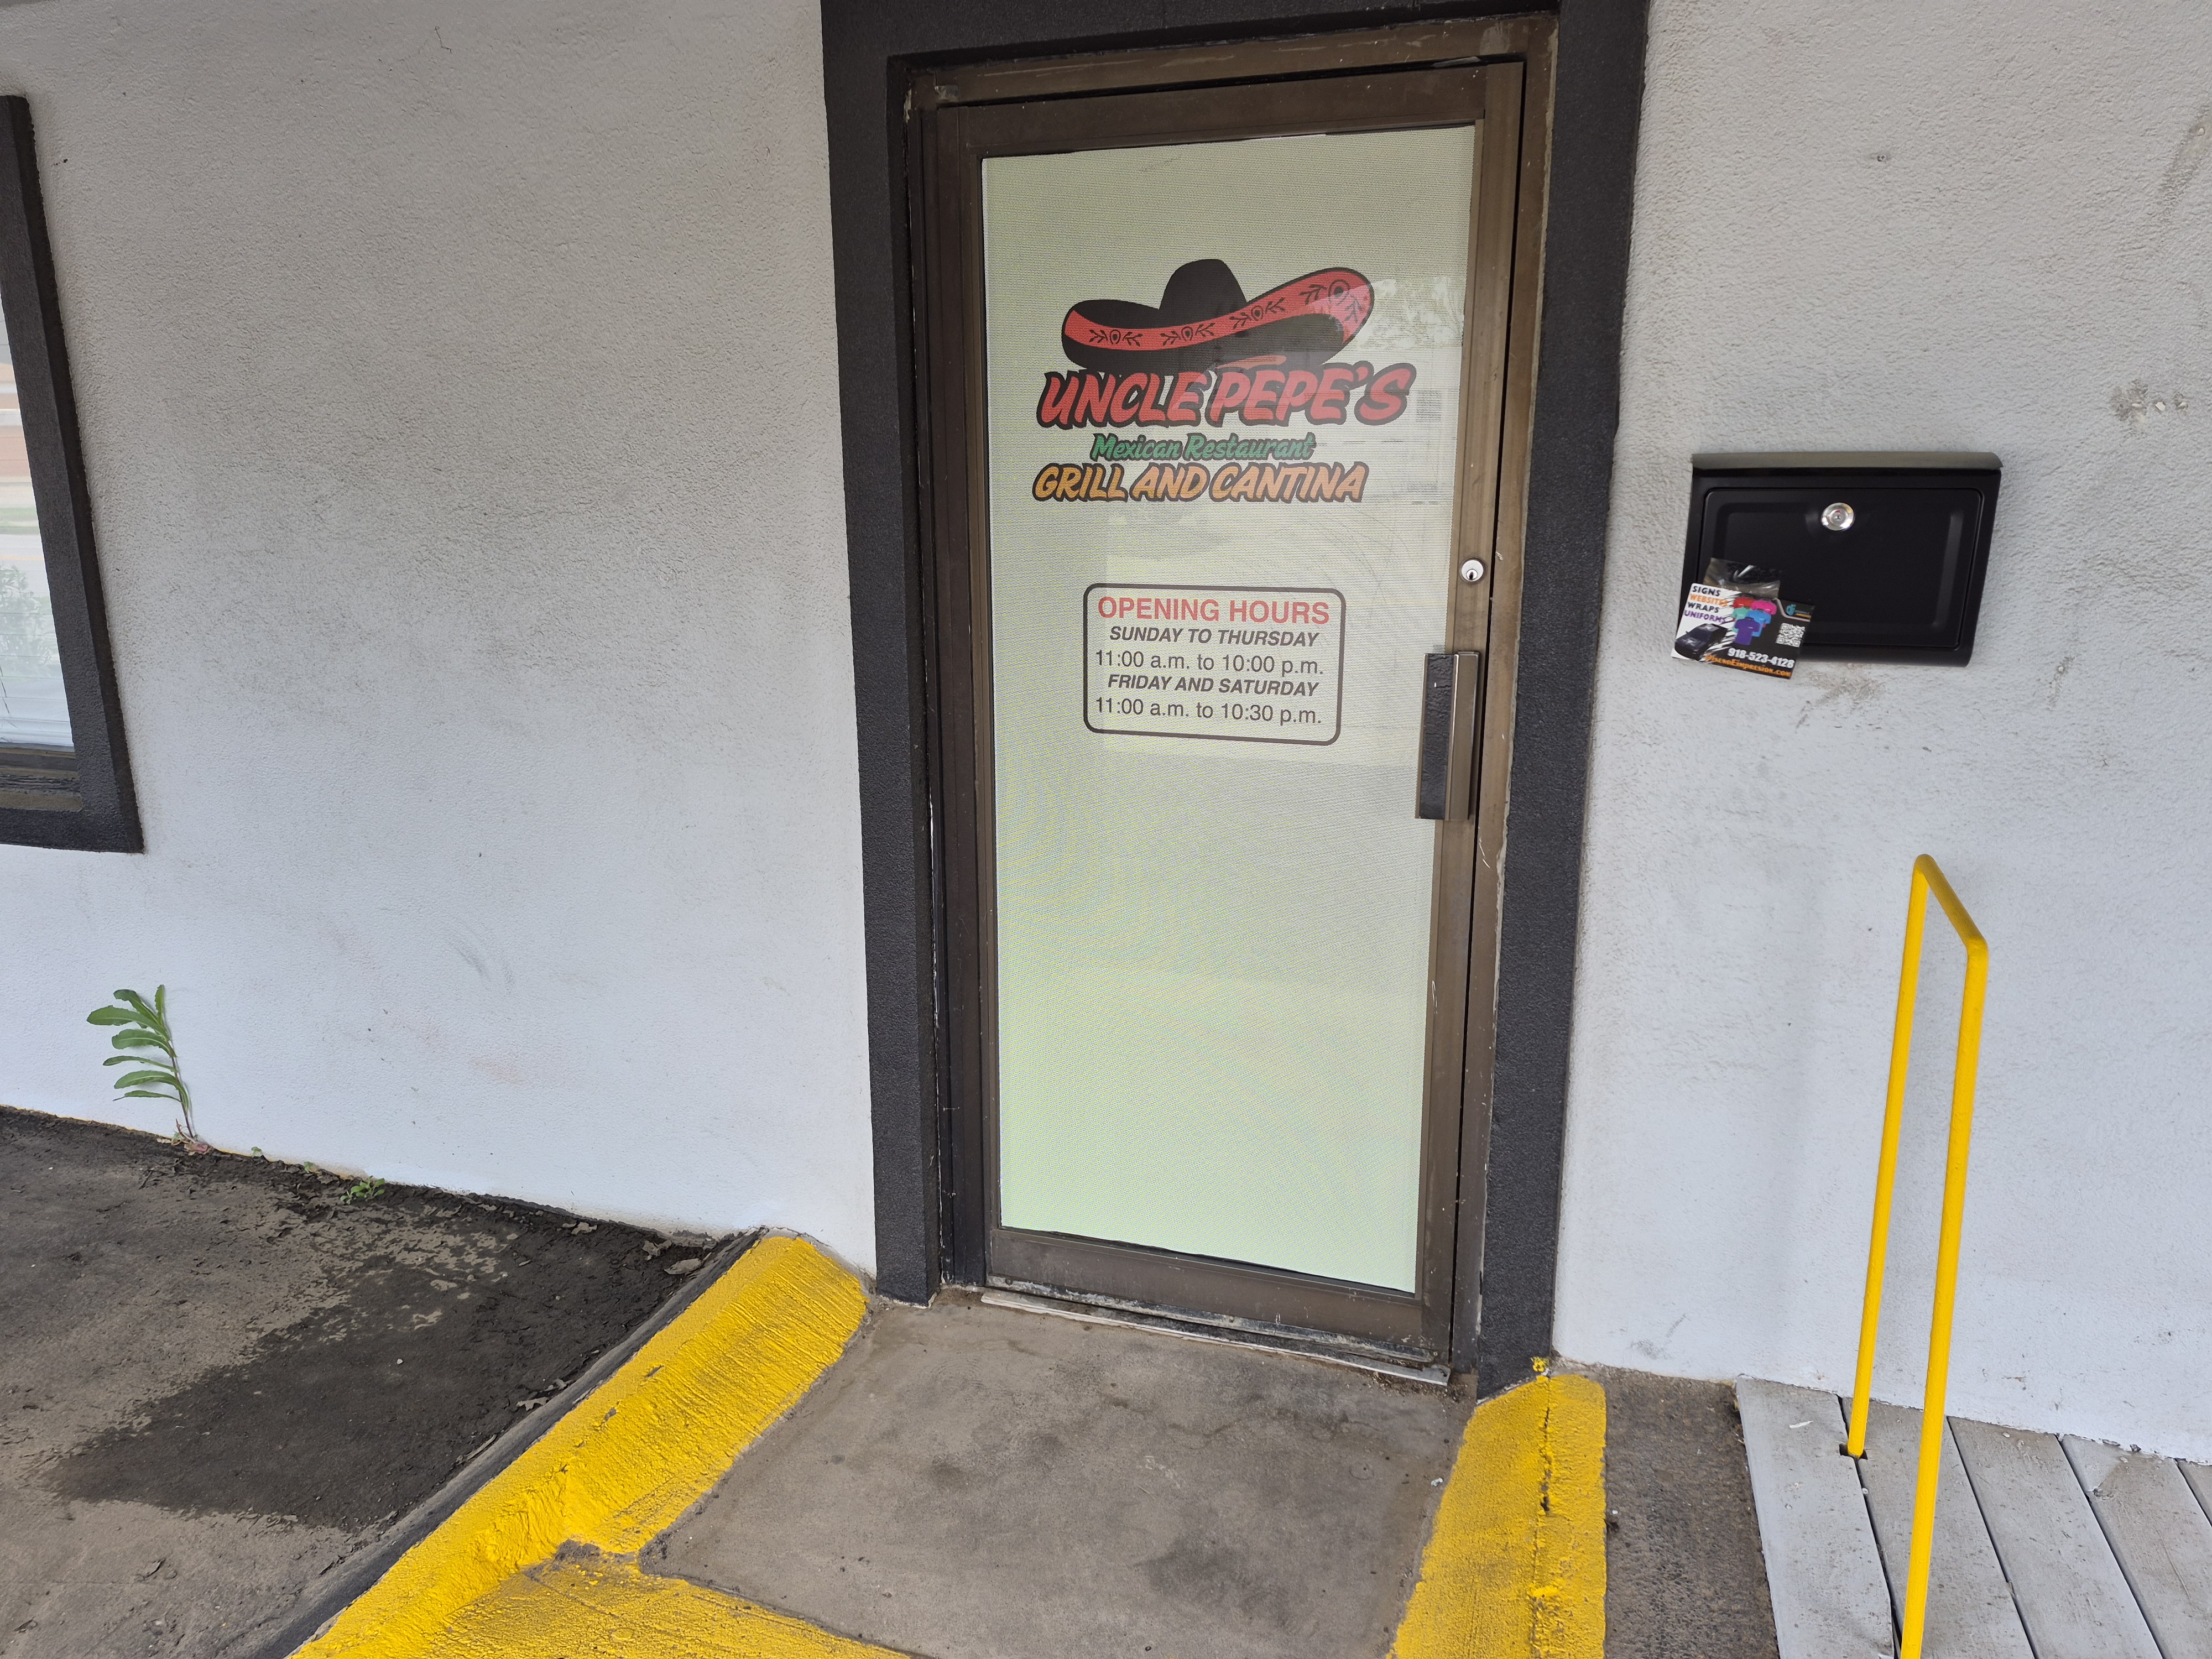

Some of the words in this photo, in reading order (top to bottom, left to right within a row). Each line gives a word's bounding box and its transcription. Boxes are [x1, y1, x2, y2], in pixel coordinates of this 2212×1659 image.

[1036, 370, 1210, 428] UNCLE
[1206, 362, 1416, 427] PEPE'S
[1090, 432, 1183, 461] Mexican
[1183, 431, 1317, 461] Restaurant
[1032, 463, 1129, 503] GRILL
[1129, 462, 1209, 503] AND
[1209, 462, 1369, 503] CANTINA
[1690, 594, 1729, 606] WEBSITES
[1692, 586, 1721, 597] SIGNS
[1098, 596, 1219, 622] OPENING
[1229, 599, 1330, 625] HOURS
[1684, 609, 1726, 623] UNIFORMS
[1687, 602, 1720, 613] WRAPS
[1109, 626, 1183, 643] SUNDAY
[1188, 628, 1212, 644] TO
[1218, 629, 1320, 647] THURSDAY
[1095, 650, 1144, 667] 11:00
[1150, 655, 1190, 670] a.m.
[1197, 654, 1214, 670] to
[1223, 655, 1275, 673] 10:00
[1281, 660, 1323, 677] p.m.
[1727, 648, 1795, 669] 918-523-4128
[1108, 674, 1172, 690] FRIDAY
[1175, 677, 1214, 692] AND
[1218, 679, 1320, 697] SATURDAY
[1095, 698, 1144, 714] 11:00
[1150, 703, 1189, 717] a.m.
[1196, 702, 1213, 718] to
[1221, 703, 1273, 721] 10:30
[1280, 708, 1322, 726] p.m.
